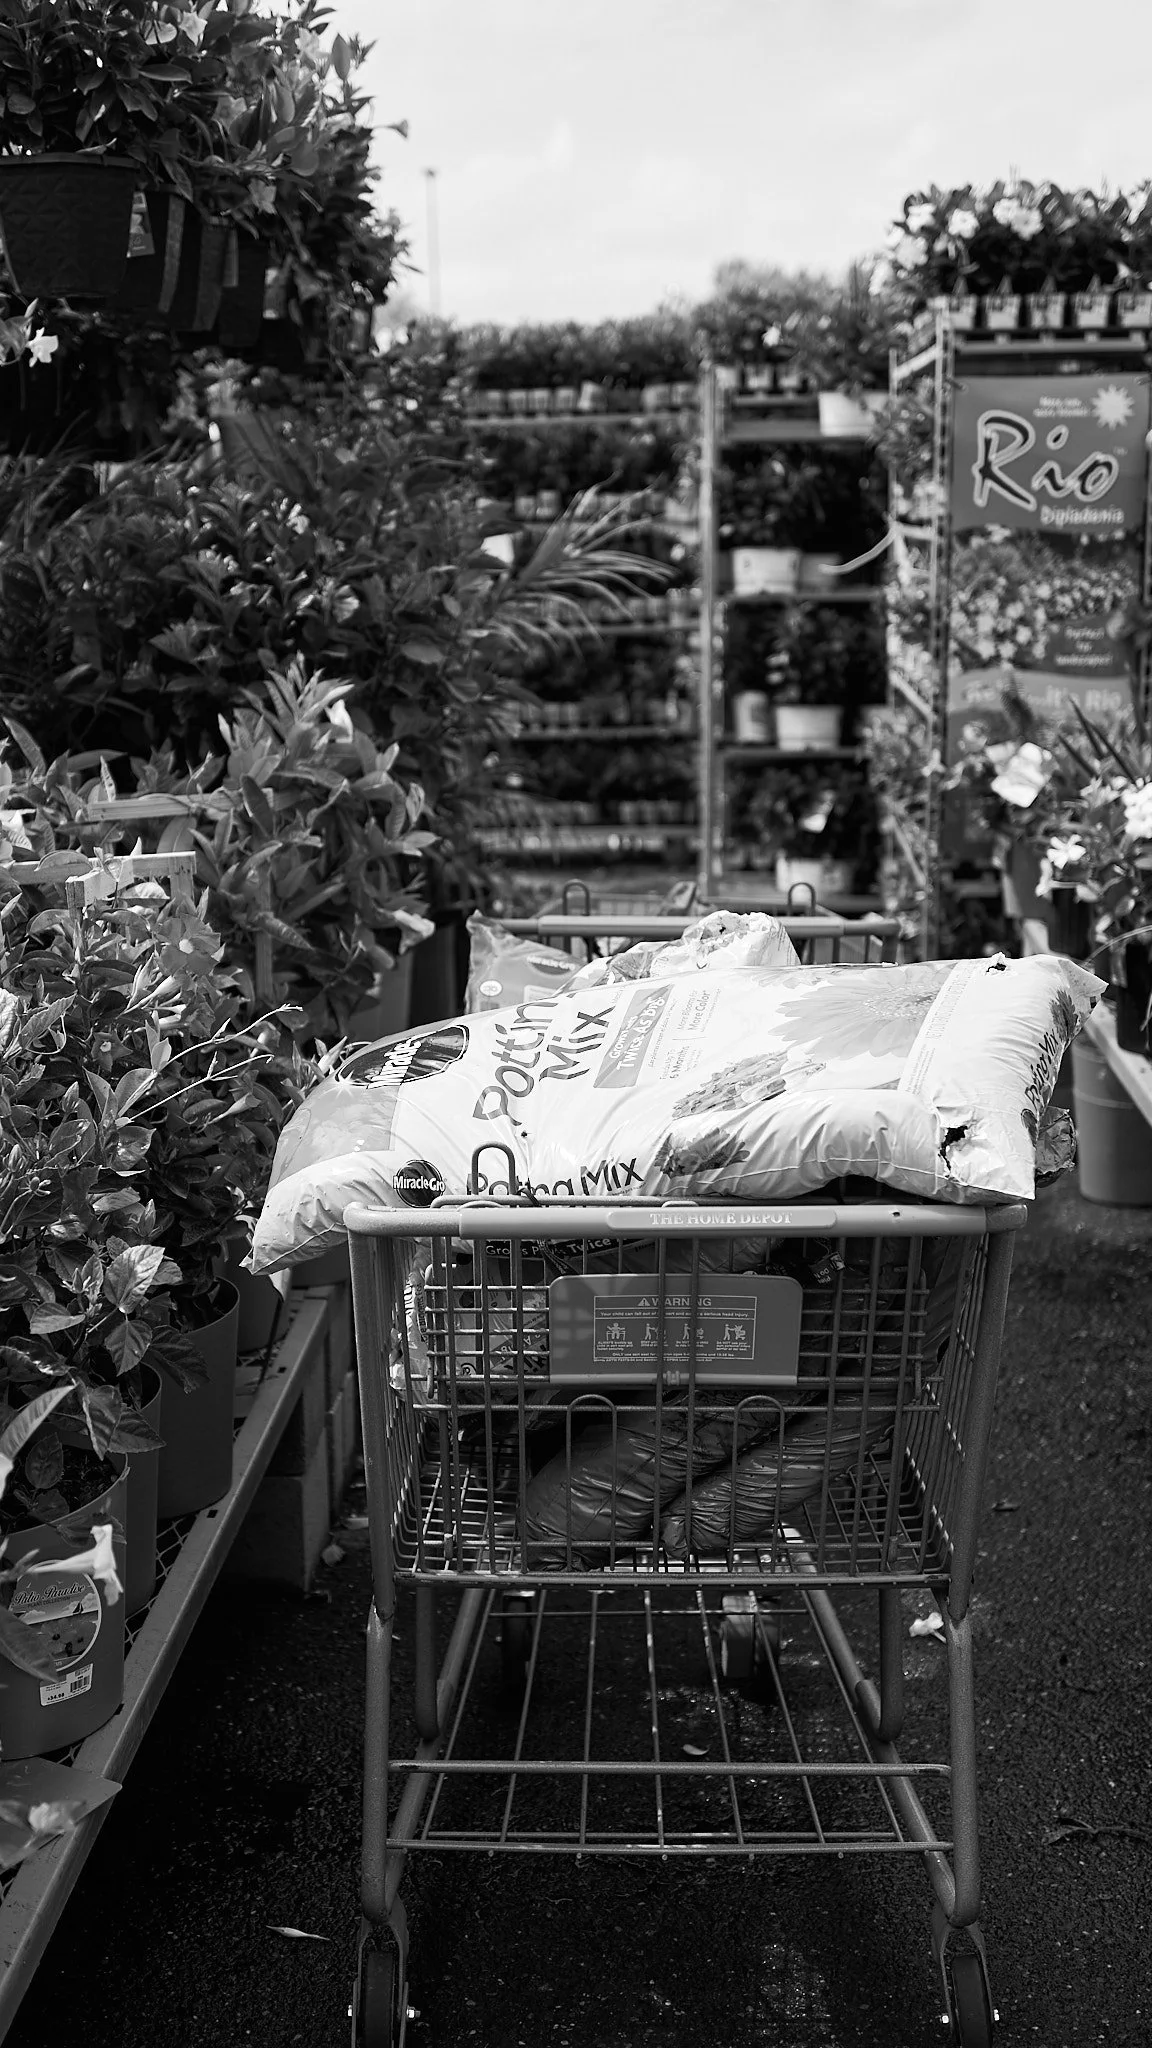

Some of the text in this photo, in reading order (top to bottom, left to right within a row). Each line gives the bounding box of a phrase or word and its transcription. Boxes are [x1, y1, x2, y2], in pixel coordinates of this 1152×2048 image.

[972, 409, 1119, 512] Rio
[473, 993, 576, 1127] Pottin
[538, 1005, 616, 1082] Mix
[393, 1175, 446, 1192] Miracle-Gro
[580, 1158, 644, 1196] Mix
[650, 1212, 793, 1225] THE HOME DEPOT
[485, 1245, 529, 1256] Gros
[651, 1297, 712, 1307] WARNNG
